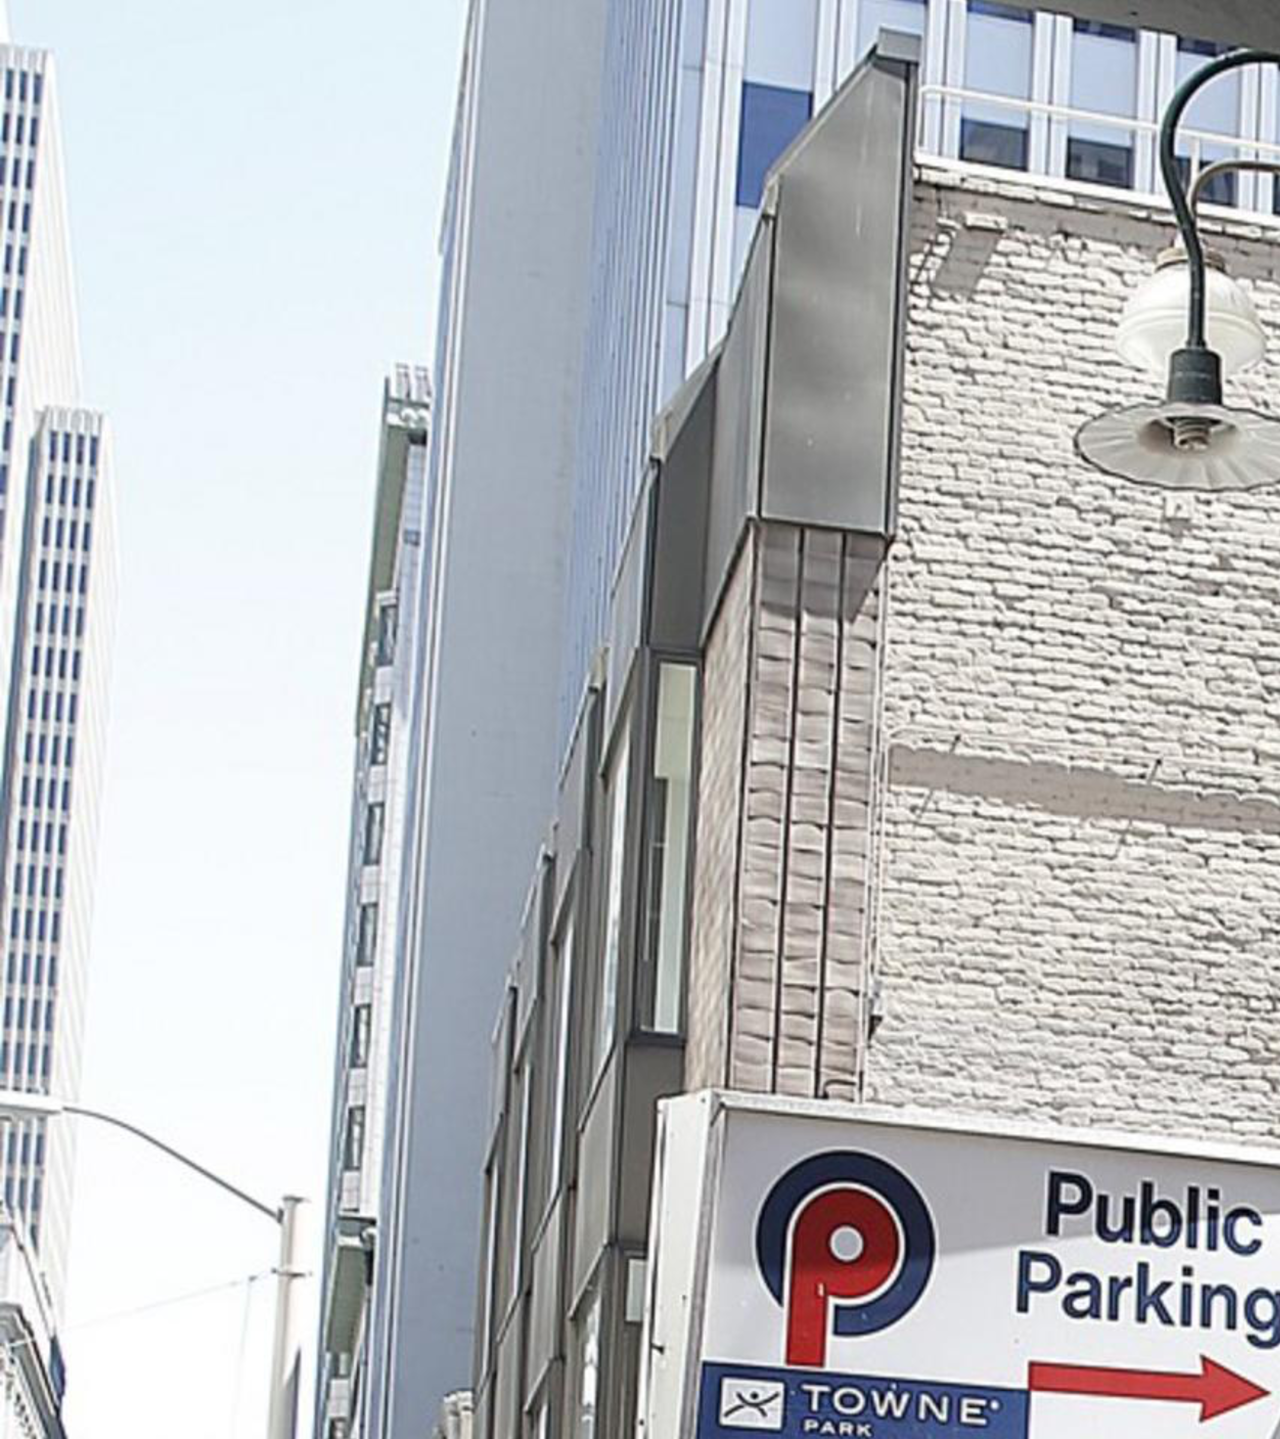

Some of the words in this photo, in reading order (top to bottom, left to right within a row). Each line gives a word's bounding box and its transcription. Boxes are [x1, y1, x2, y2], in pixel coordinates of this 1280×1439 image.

[1044, 1169, 1264, 1257] Public
[802, 1384, 988, 1426] TOWNE
[803, 1421, 873, 1438] PARK
